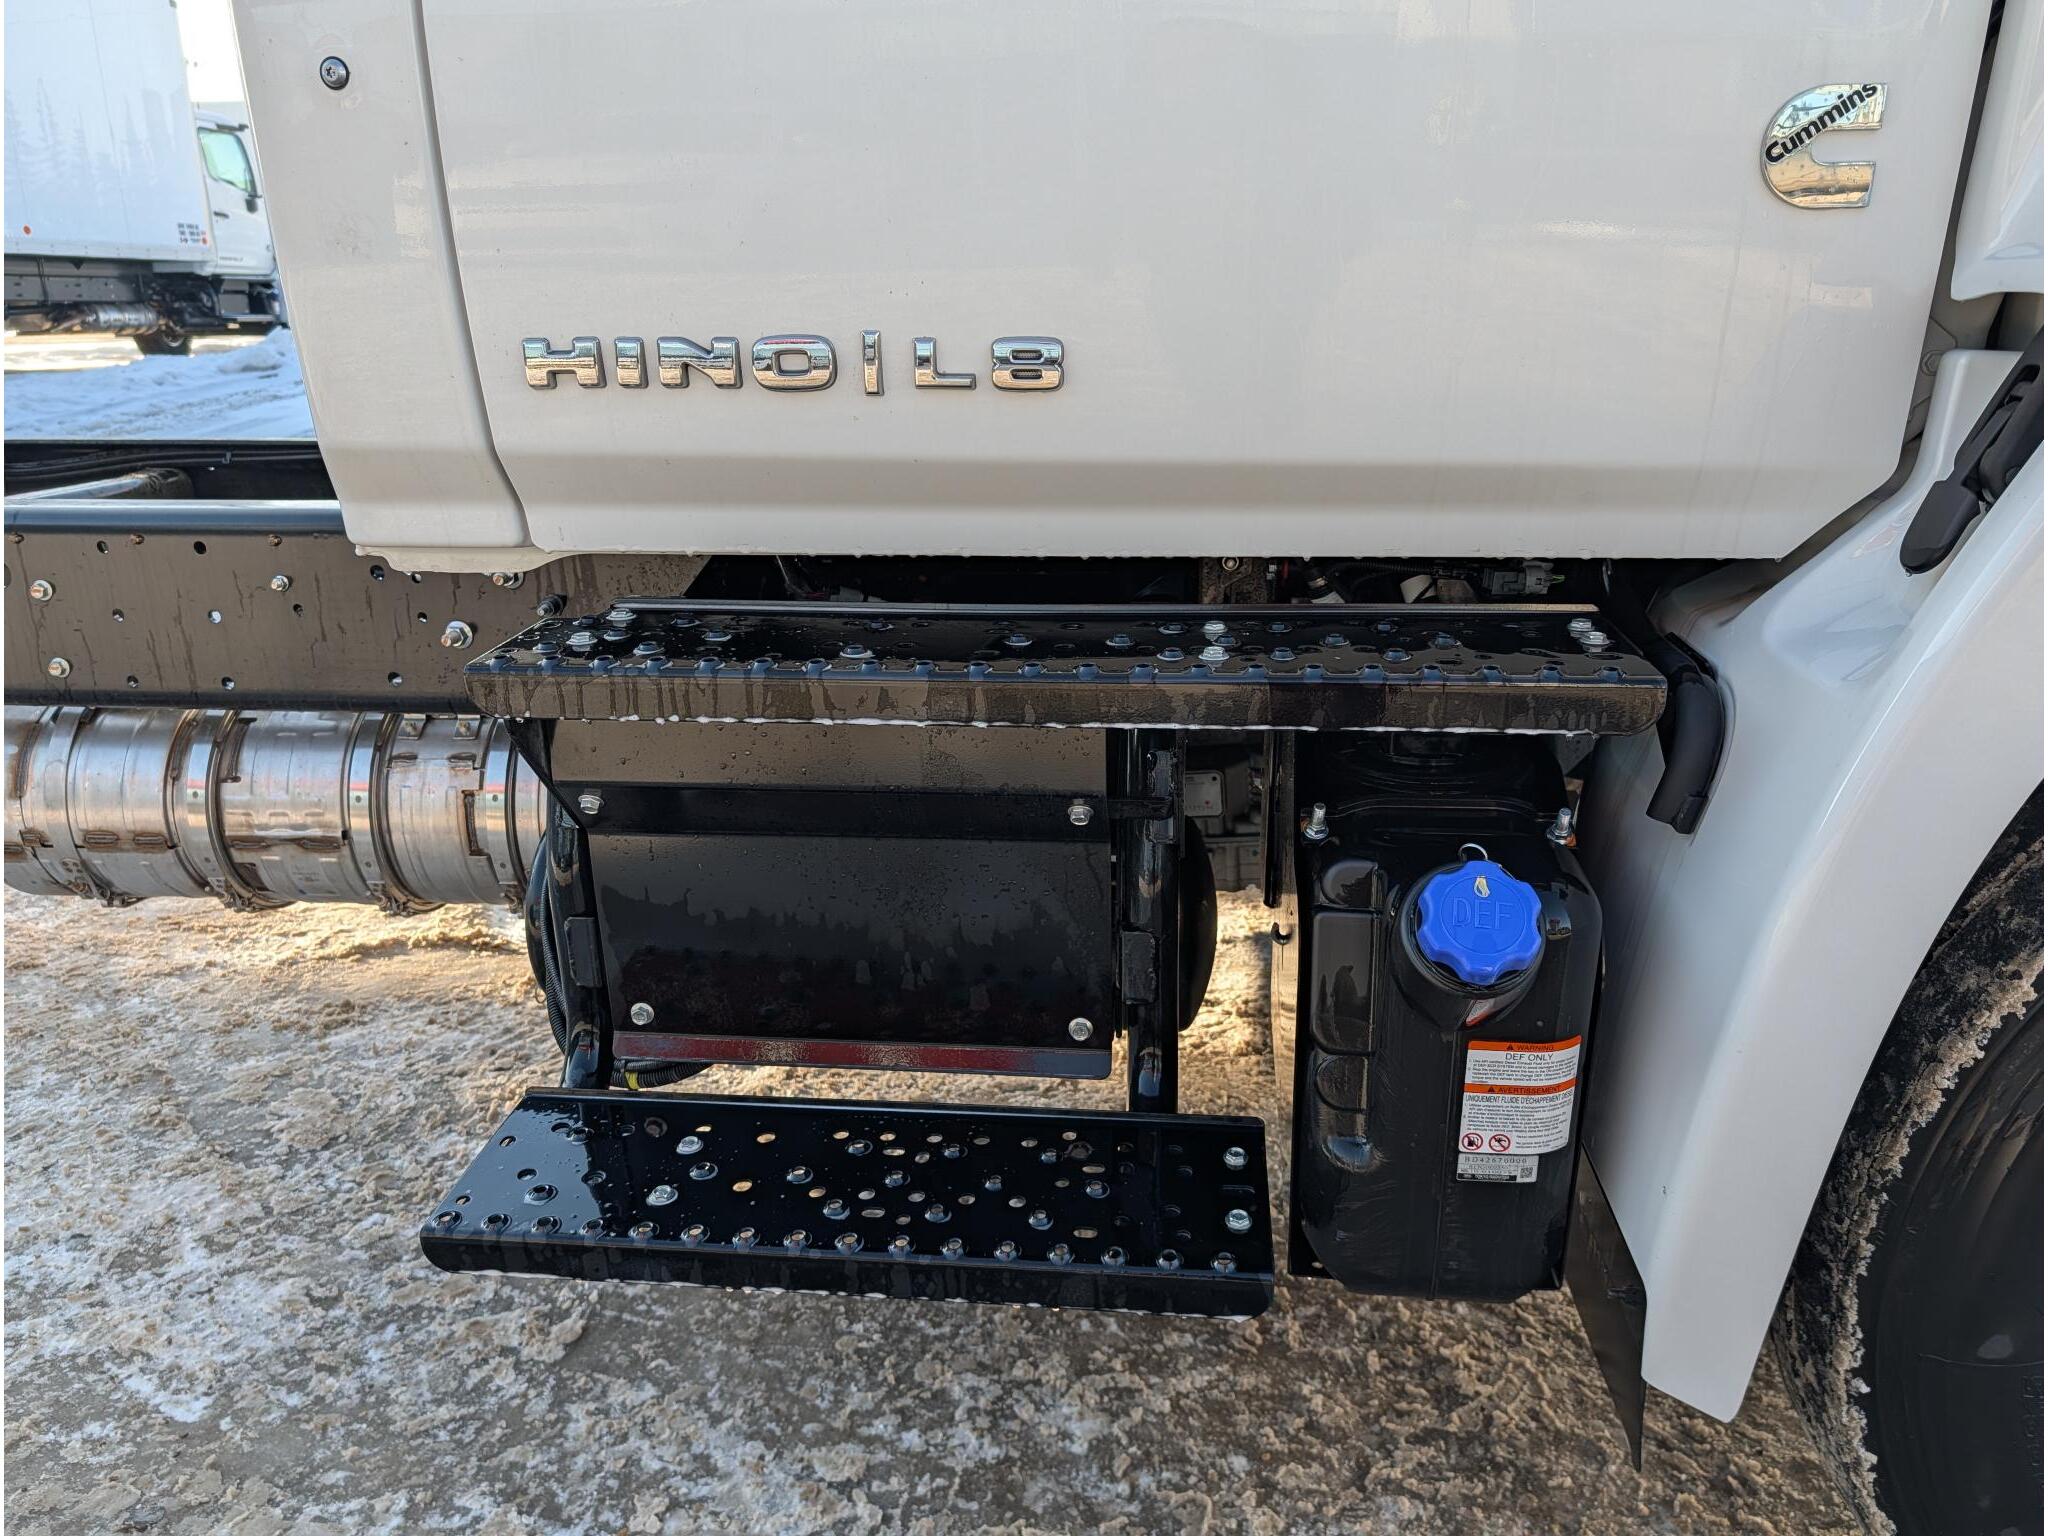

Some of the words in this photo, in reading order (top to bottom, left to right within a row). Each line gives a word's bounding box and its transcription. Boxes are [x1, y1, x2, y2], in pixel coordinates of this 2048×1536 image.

[1765, 84, 1878, 163] Cummins
[522, 335, 837, 392] HINO
[912, 336, 1065, 392] L8
[1452, 897, 1513, 929] DEF
[1505, 1053, 1525, 1061] DEF
[1528, 1053, 1554, 1061] ONLY
[1517, 1044, 1554, 1052] WARNING
[1498, 1087, 1560, 1095] AVERTISSEMENT
